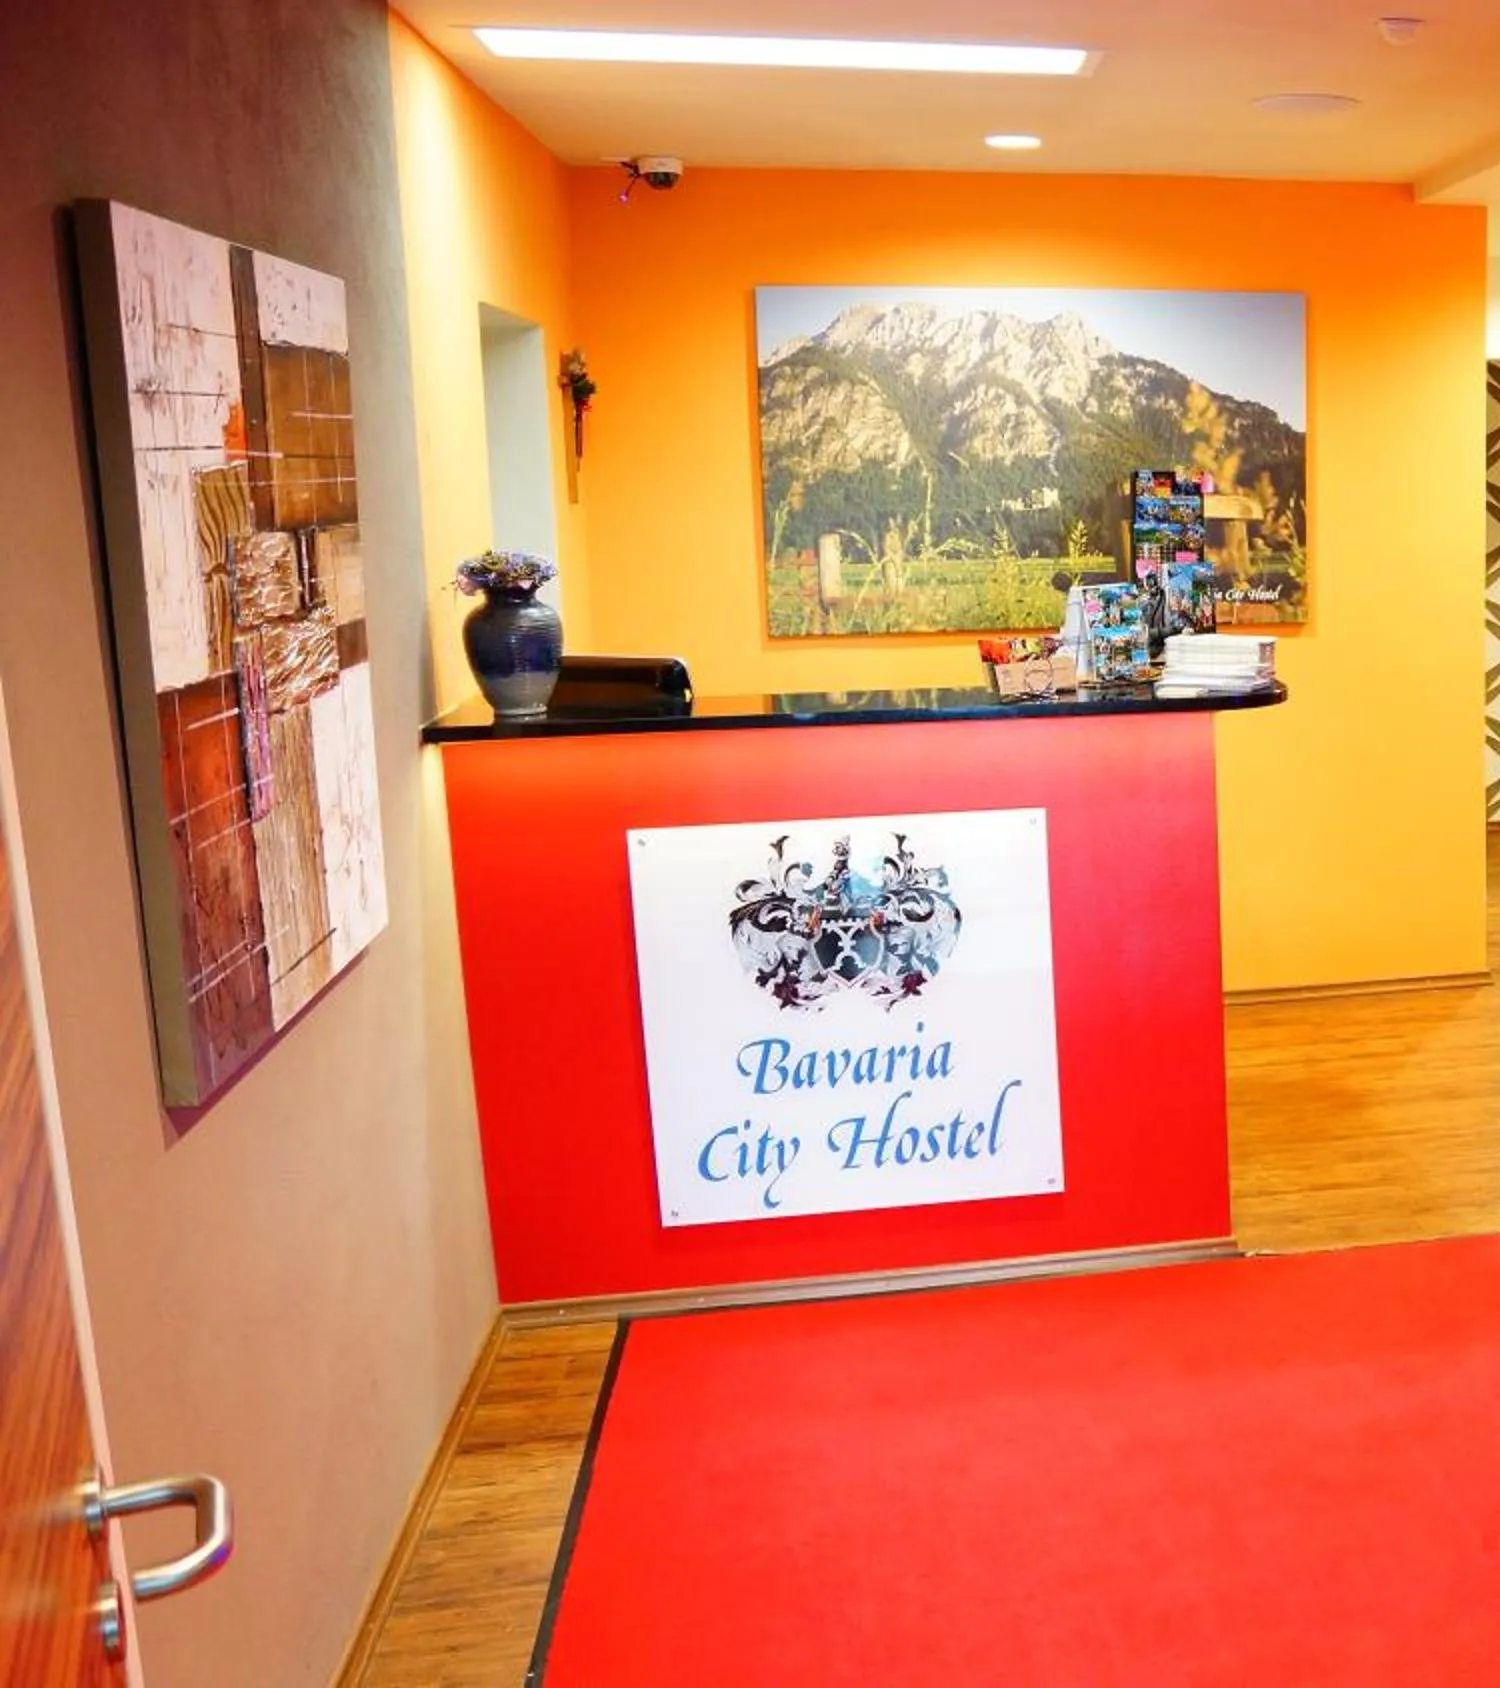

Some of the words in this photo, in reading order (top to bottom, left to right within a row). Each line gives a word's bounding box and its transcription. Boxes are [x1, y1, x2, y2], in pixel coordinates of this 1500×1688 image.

[735, 1021, 957, 1095] Bavaria
[697, 1119, 801, 1209] City
[827, 1079, 1022, 1171] Hostel
